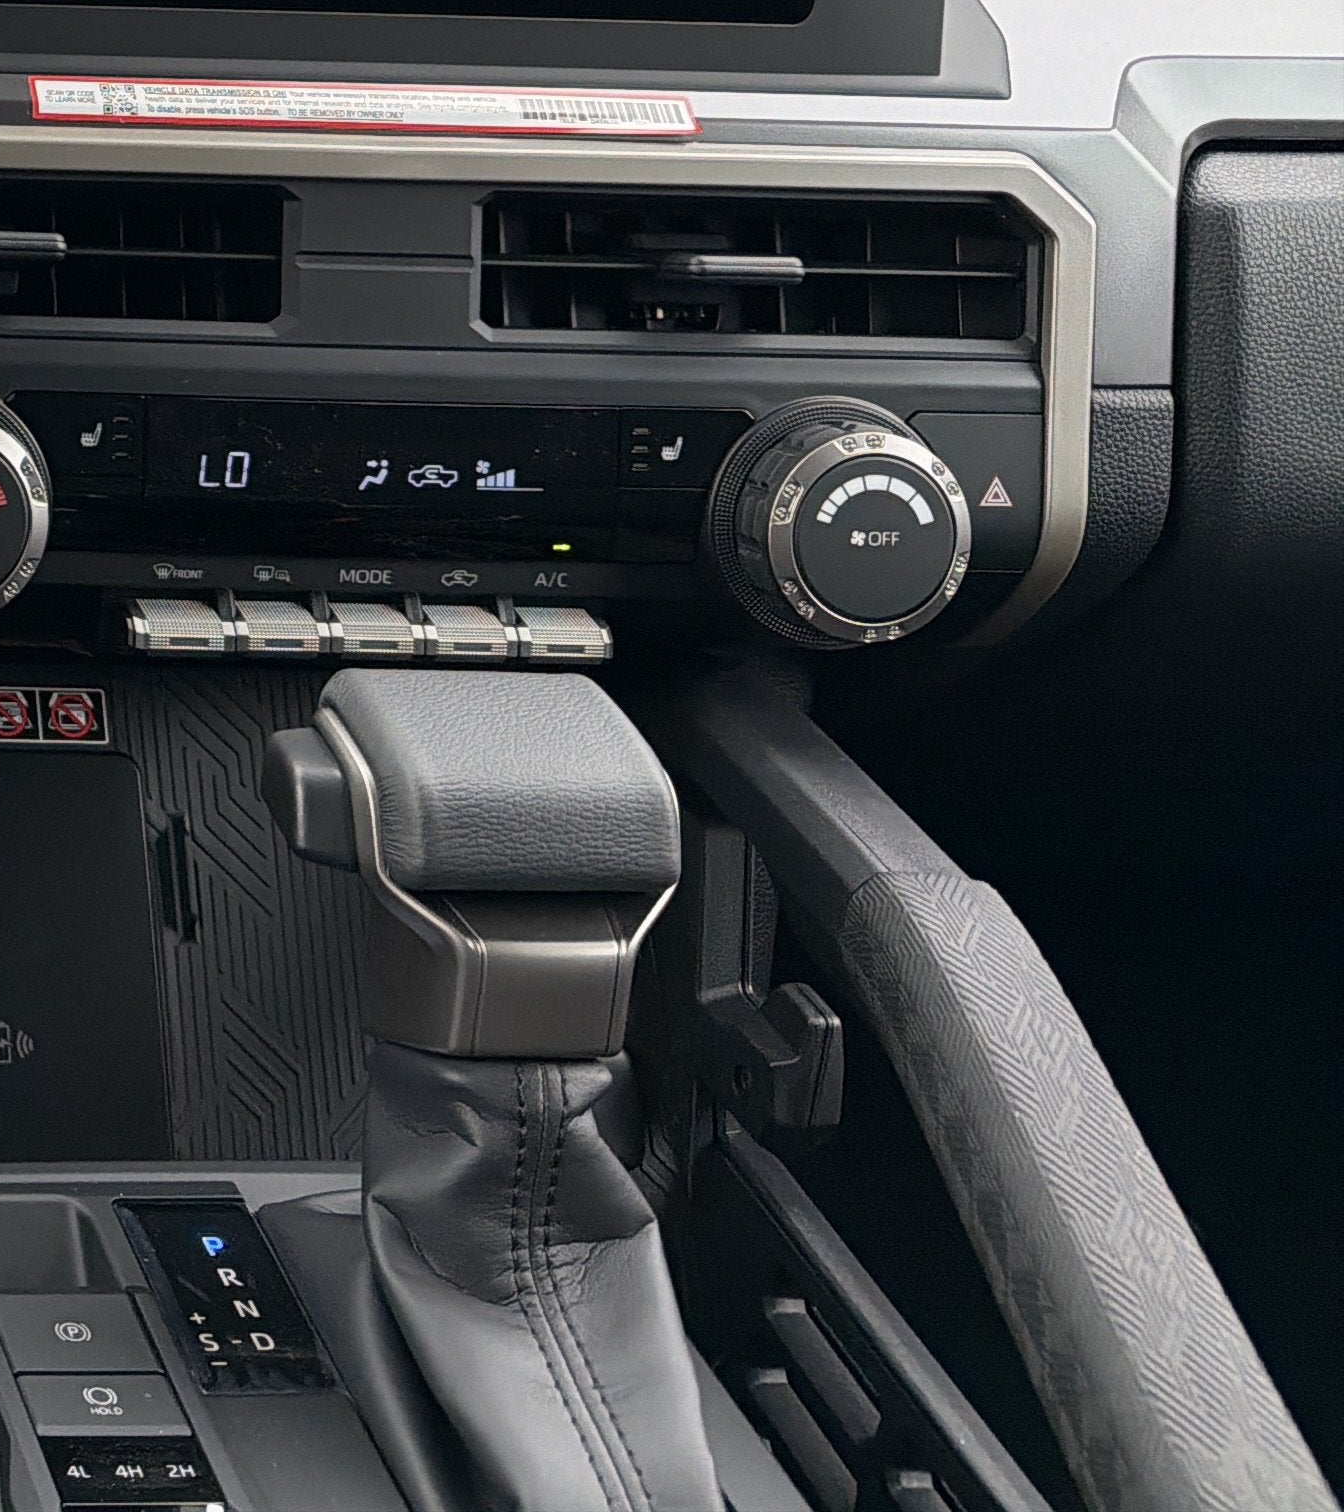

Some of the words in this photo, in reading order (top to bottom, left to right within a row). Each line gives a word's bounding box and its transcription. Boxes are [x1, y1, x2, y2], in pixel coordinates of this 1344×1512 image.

[199, 451, 250, 487] LO
[868, 531, 901, 547] OFF
[173, 569, 204, 580] FRONT
[339, 568, 392, 584] MODE
[534, 571, 568, 588] A/C
[201, 1235, 228, 1257] P
[217, 1268, 245, 1287] R
[234, 1299, 261, 1319] N
[199, 1332, 219, 1352] S
[250, 1332, 275, 1351] D
[89, 1406, 124, 1416] HOLD
[67, 1464, 91, 1478] 4L
[115, 1464, 144, 1479] 4H
[166, 1464, 196, 1479] 2H
